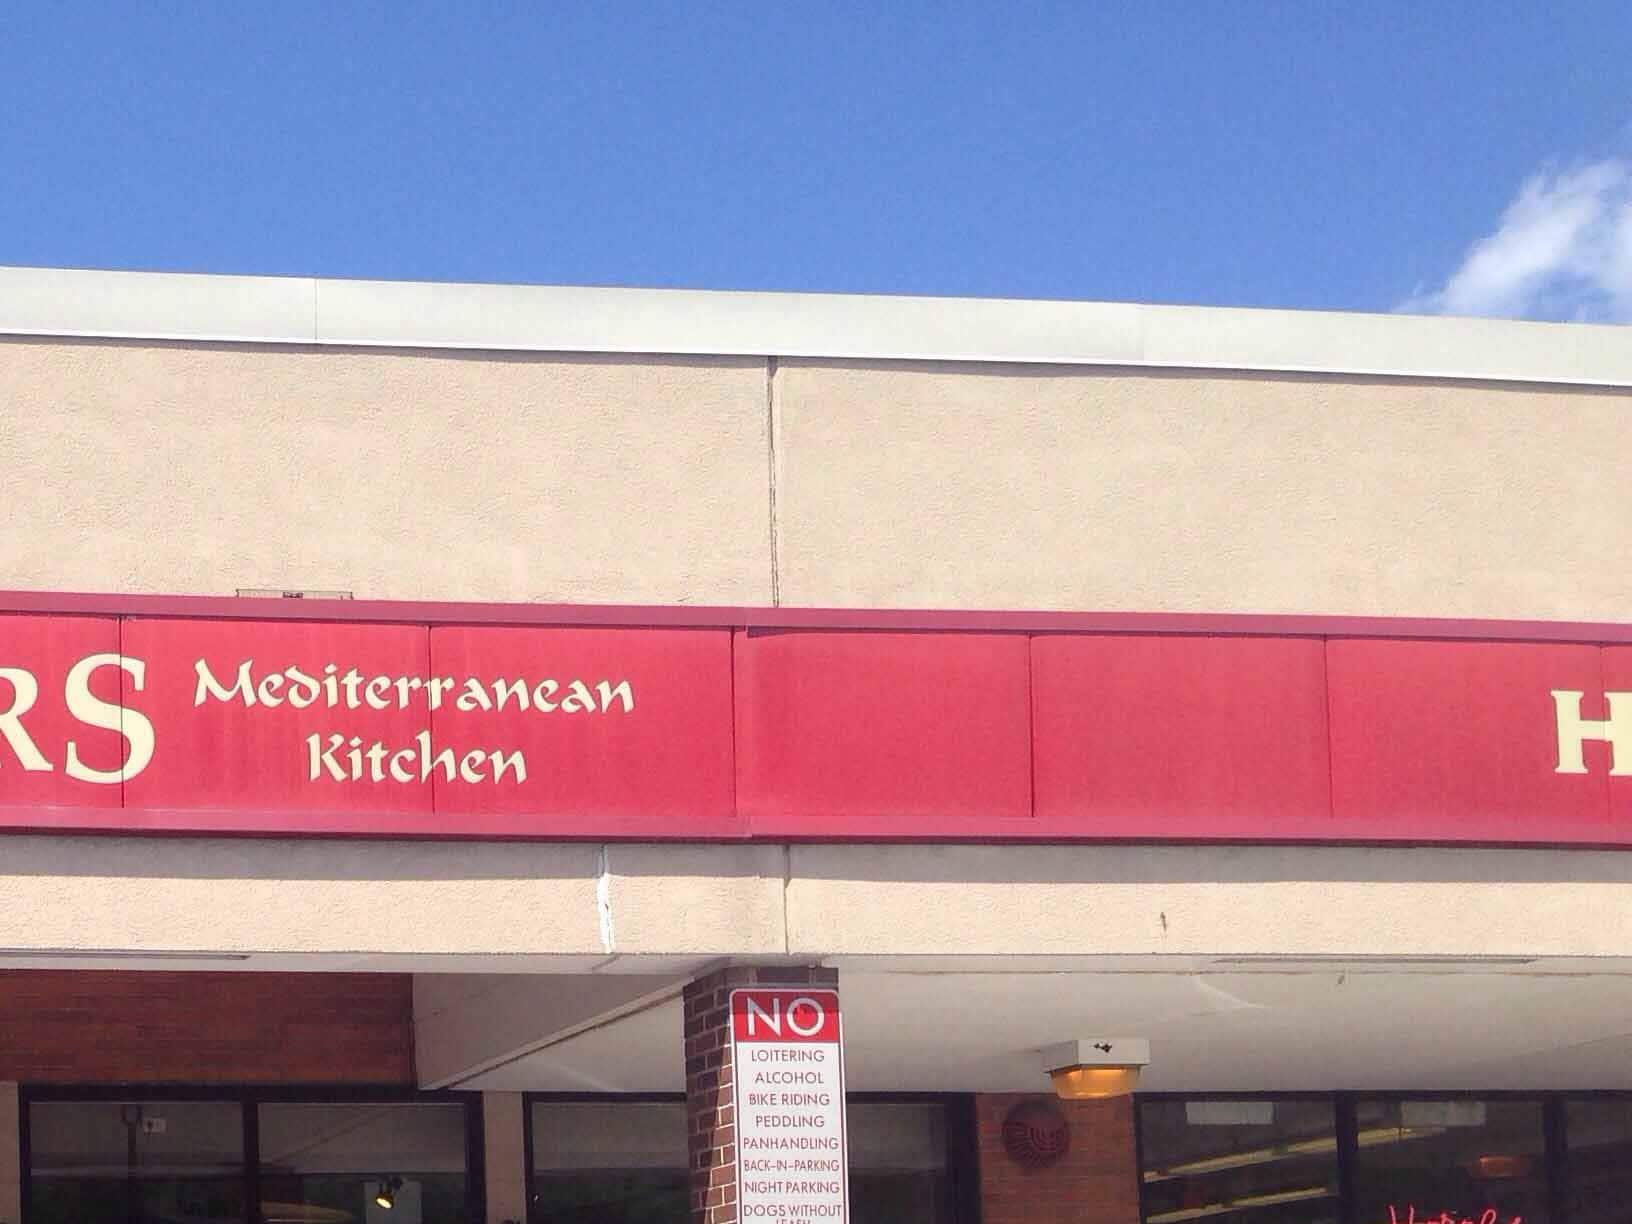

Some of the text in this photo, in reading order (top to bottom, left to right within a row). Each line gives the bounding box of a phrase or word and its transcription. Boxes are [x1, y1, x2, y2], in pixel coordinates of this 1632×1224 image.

[193, 657, 636, 713] Mediterranean
[306, 730, 528, 784] Kitchen
[746, 996, 825, 1037] NO
[751, 1049, 825, 1062] LOITERING
[755, 1071, 825, 1084] ALCOHOL
[749, 1093, 830, 1106] BIKE RIDING
[755, 1115, 825, 1128] PEDDLING
[743, 1137, 839, 1150] PANHANDLING
[744, 1159, 840, 1172] BACK-IN-PARKING
[744, 1181, 840, 1194] NIGHT PARKING
[743, 1204, 842, 1217] DOGS WITHOUT
